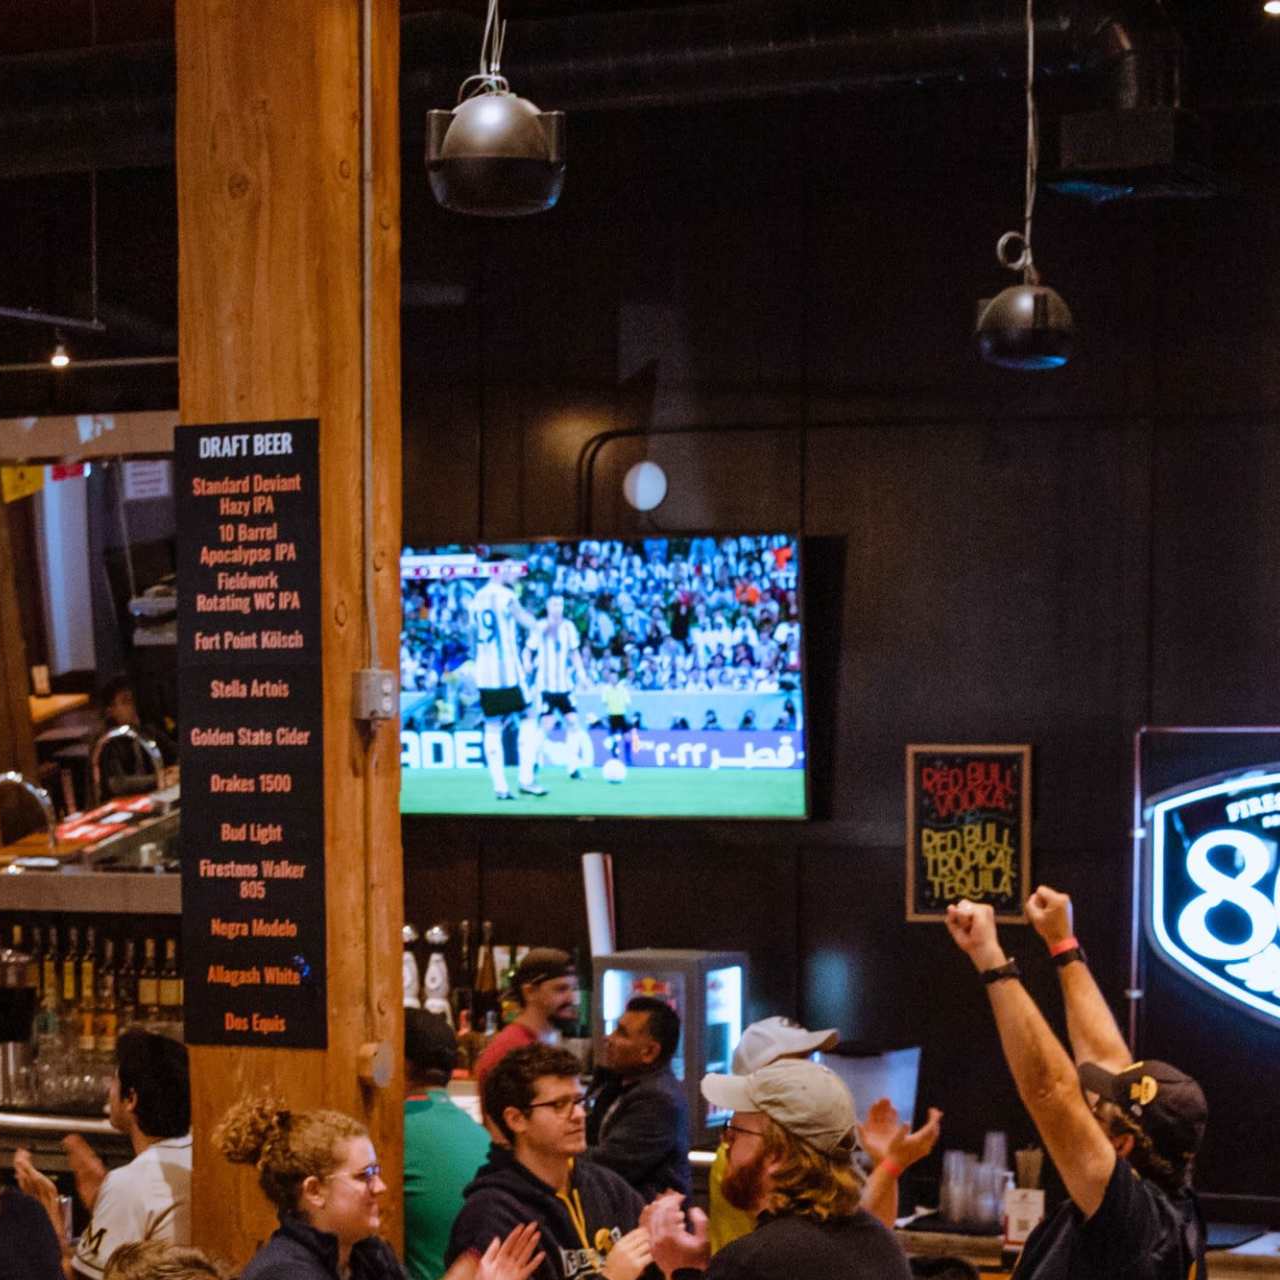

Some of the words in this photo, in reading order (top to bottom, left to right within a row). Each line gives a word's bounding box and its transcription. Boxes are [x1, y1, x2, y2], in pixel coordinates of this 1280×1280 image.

[199, 434, 249, 459] DRAFT
[254, 431, 293, 455] BEER
[192, 476, 250, 497] Standard
[253, 474, 301, 493] Deviant
[219, 497, 251, 518] Hazy
[253, 495, 275, 513] IPA
[218, 524, 234, 542] 10
[238, 522, 278, 542] Barrel
[199, 546, 272, 568] Apocalypse
[275, 543, 297, 562] IPA
[217, 571, 279, 590] Fieldwork
[196, 593, 251, 615] Rotating
[254, 592, 275, 610] WC
[278, 591, 301, 610] IPA
[195, 631, 221, 651] Fort
[224, 630, 258, 650] Point
[261, 628, 304, 649] Kölsch
[210, 679, 248, 699] Stella
[251, 678, 290, 698] Artois
[191, 728, 235, 747] Golden
[238, 728, 273, 746] State
[276, 727, 311, 746] Cider
[210, 773, 255, 793] Drakes
[259, 773, 292, 793] 1500
[221, 823, 247, 842] Bud
[250, 823, 283, 845] Light
[922, 827, 962, 852] RED
[963, 822, 1010, 850] BULL
[199, 858, 258, 879] Firestone
[262, 859, 307, 880] Walker
[924, 846, 1015, 882] TROPICAL
[240, 880, 267, 900] 805
[931, 866, 1014, 900] TEQUILA
[211, 918, 249, 940] Negra
[252, 918, 298, 938] Modelo
[207, 965, 261, 987] Allagash
[264, 966, 301, 986] White
[224, 1012, 249, 1032] Dos
[252, 1013, 286, 1035] Equis
